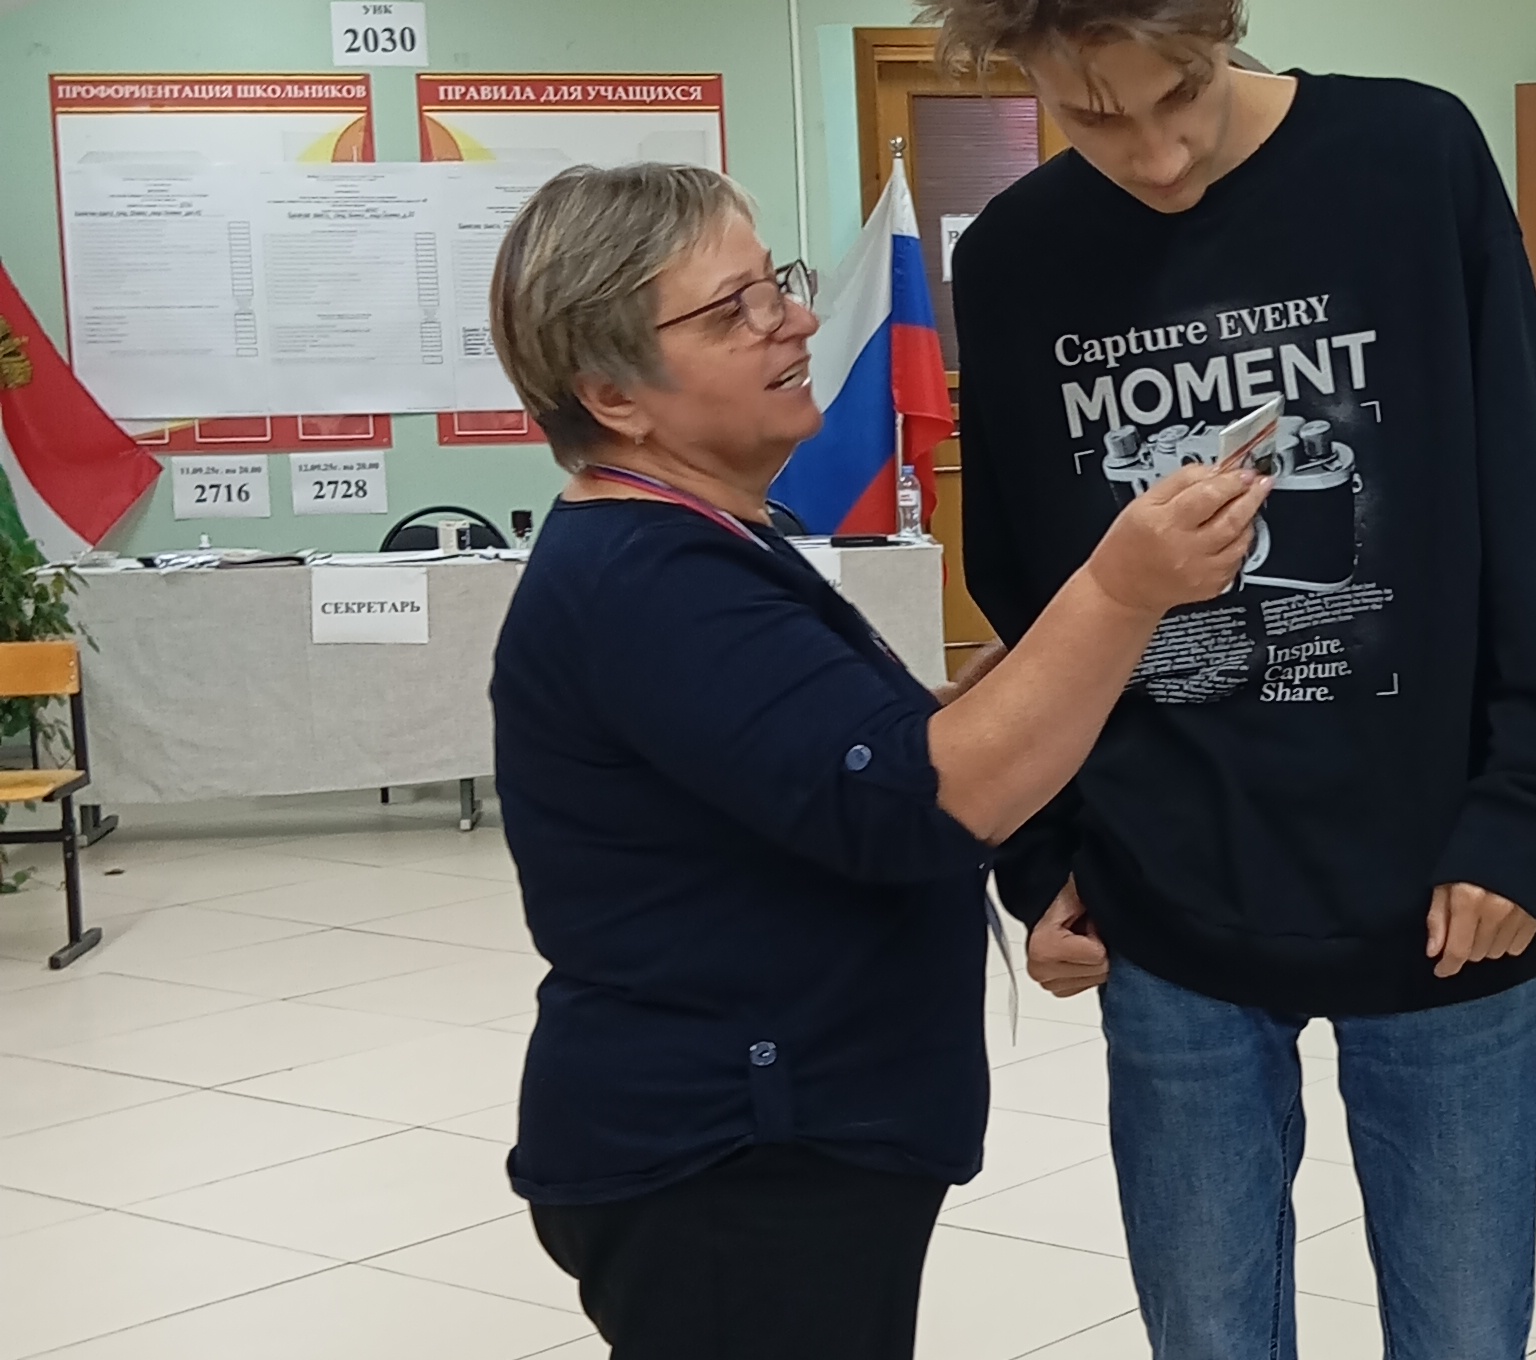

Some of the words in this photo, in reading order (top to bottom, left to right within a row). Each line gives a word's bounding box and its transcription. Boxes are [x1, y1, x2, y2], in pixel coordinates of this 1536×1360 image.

[362, 5, 393, 15] УИК
[343, 27, 415, 53] 2030
[58, 84, 233, 101] ПРОФОРИЕНТАЦИЯ
[237, 85, 366, 99] ШКОЛЬНИКОВ
[438, 86, 535, 100] ПРАВИЛА
[540, 86, 582, 102] ДЛЯ
[588, 86, 702, 103] УЧАЩИХСЯ
[1054, 317, 1207, 369] Capture
[1216, 294, 1330, 340] EVERY
[1061, 330, 1376, 438] MOMENT
[195, 484, 250, 503] 2716
[313, 479, 367, 499] 2728
[321, 601, 420, 615] СЕКРЕТАРЬ
[1267, 636, 1344, 665] Inspire.
[1264, 660, 1352, 683] Capture.
[1260, 684, 1334, 701] Share.
